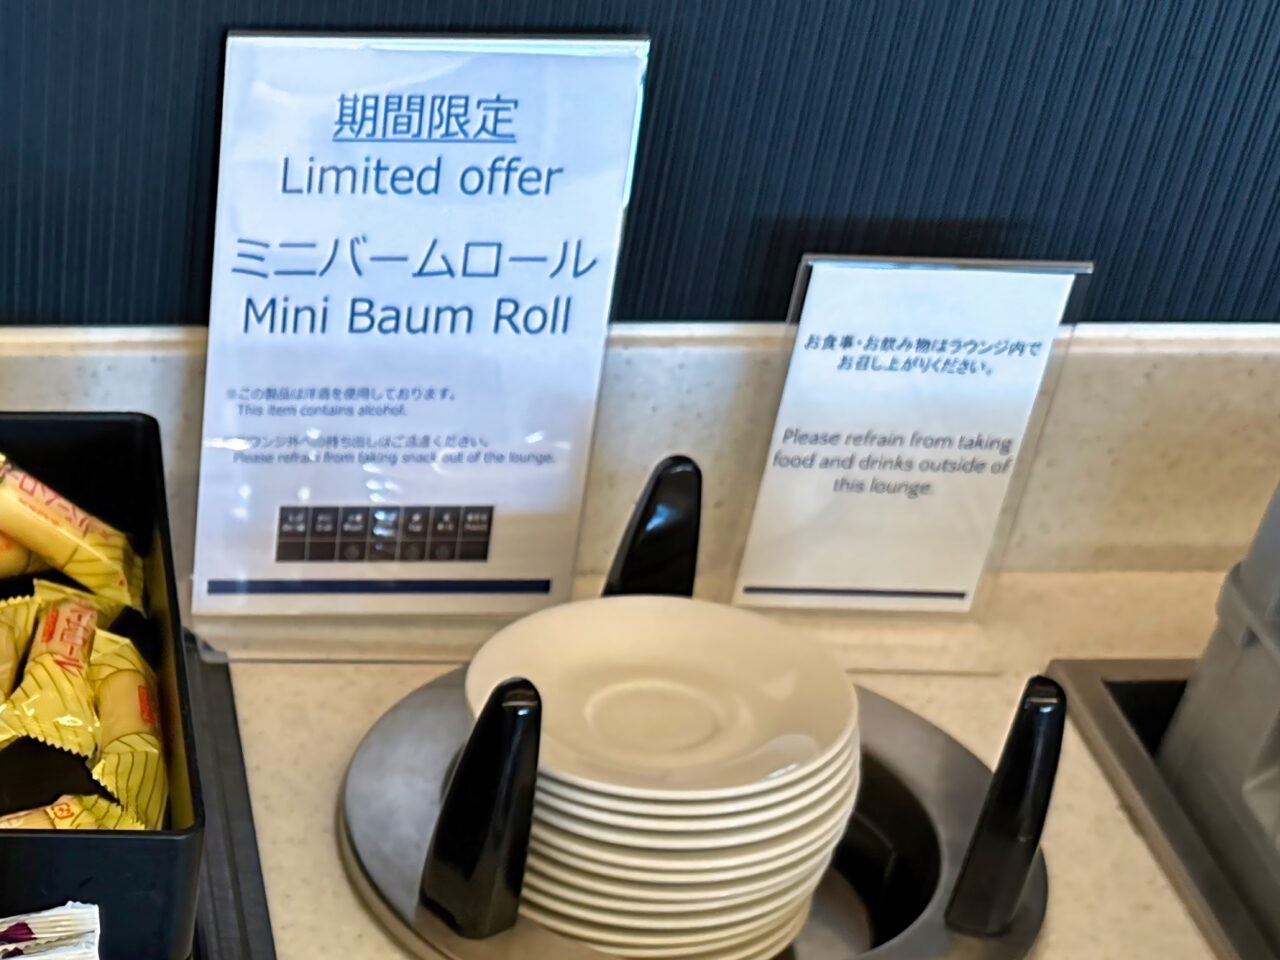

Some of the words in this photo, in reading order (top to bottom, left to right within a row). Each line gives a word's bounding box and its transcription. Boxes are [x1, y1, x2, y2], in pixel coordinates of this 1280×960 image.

[334, 93, 519, 139] 期間限定
[280, 155, 442, 195] Limited
[459, 156, 565, 196] offer
[231, 235, 598, 280] ミニバームロール
[243, 296, 330, 335] Mini
[347, 297, 474, 335] Baum
[493, 297, 572, 335] Roll
[238, 403, 264, 416] This
[267, 404, 297, 416] item
[300, 404, 355, 416] contains
[782, 428, 842, 446] Please
[844, 430, 905, 448] refrain
[908, 431, 953, 449] from
[958, 433, 1014, 455] taking
[233, 451, 274, 464] Please
[323, 451, 355, 464] from
[358, 451, 399, 466] taking
[401, 451, 437, 464] snack
[440, 452, 464, 464] out
[466, 451, 482, 464] of
[483, 451, 506, 464] the
[772, 452, 817, 469] food
[819, 454, 855, 470] and
[858, 454, 914, 472] drinks
[918, 456, 987, 473] outside
[990, 456, 1013, 474] of
[833, 475, 866, 493] this
